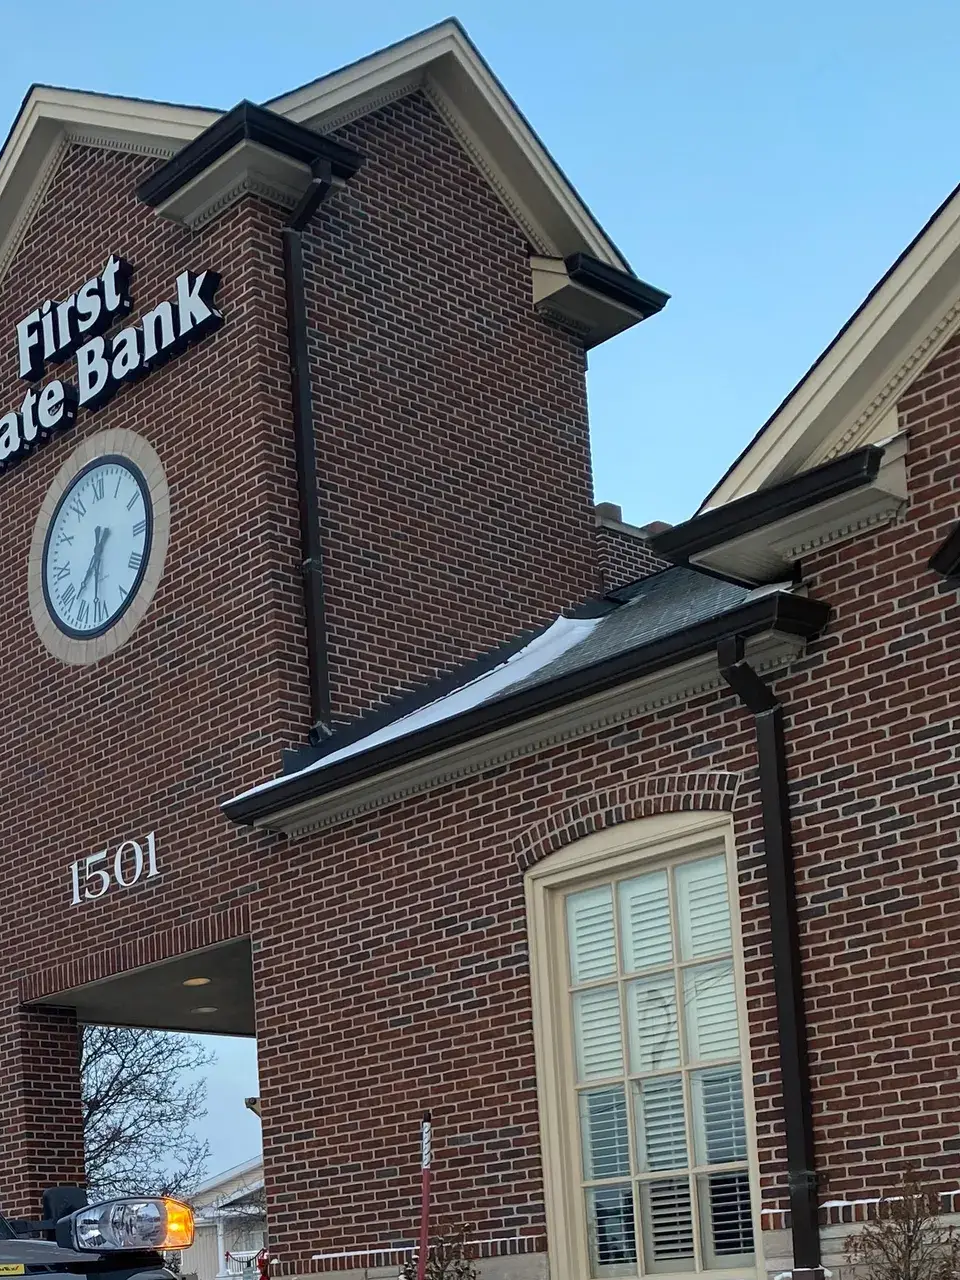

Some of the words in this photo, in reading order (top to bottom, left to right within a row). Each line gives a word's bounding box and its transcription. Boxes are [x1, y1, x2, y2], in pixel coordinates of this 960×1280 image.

[16, 254, 128, 380] First
[76, 268, 224, 408] Bank
[69, 830, 161, 906] 1501
